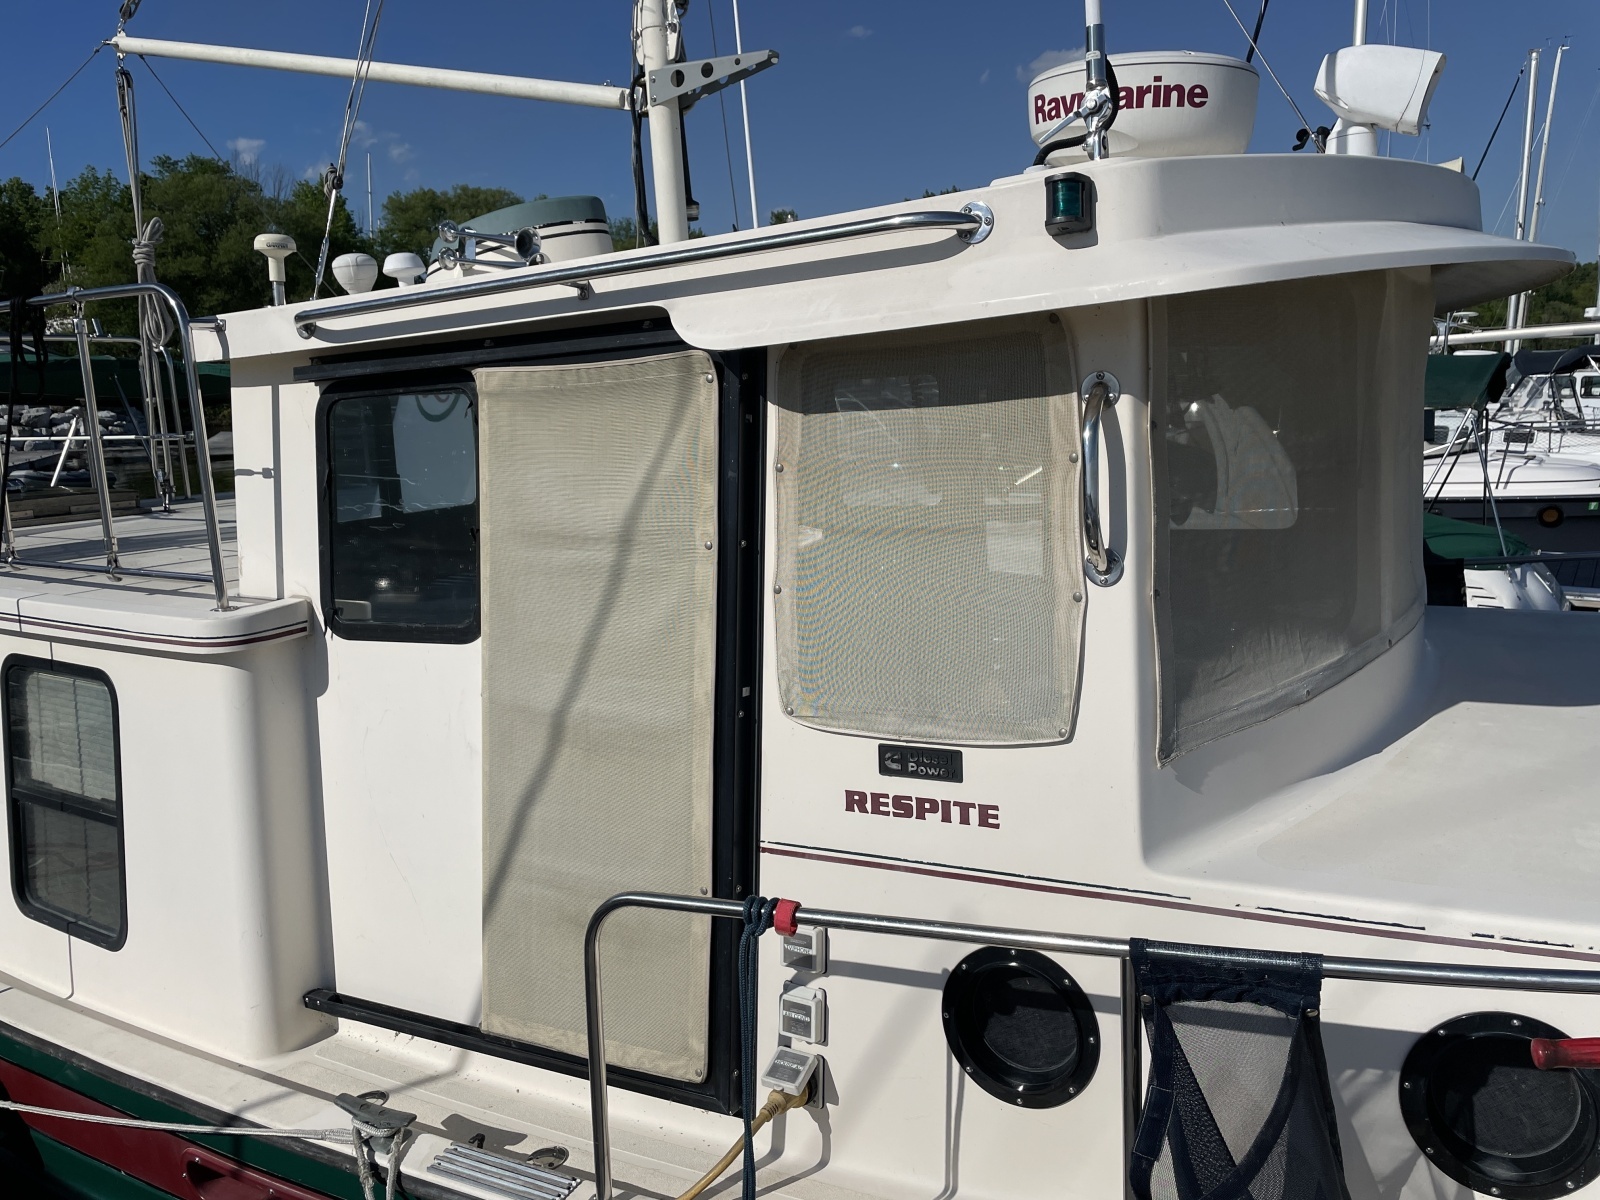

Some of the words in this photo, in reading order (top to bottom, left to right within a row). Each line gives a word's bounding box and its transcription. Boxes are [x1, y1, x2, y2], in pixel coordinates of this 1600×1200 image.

[1034, 75, 1209, 124] Rayarine
[908, 762, 956, 778] Power
[844, 789, 1001, 829] RESPITE
